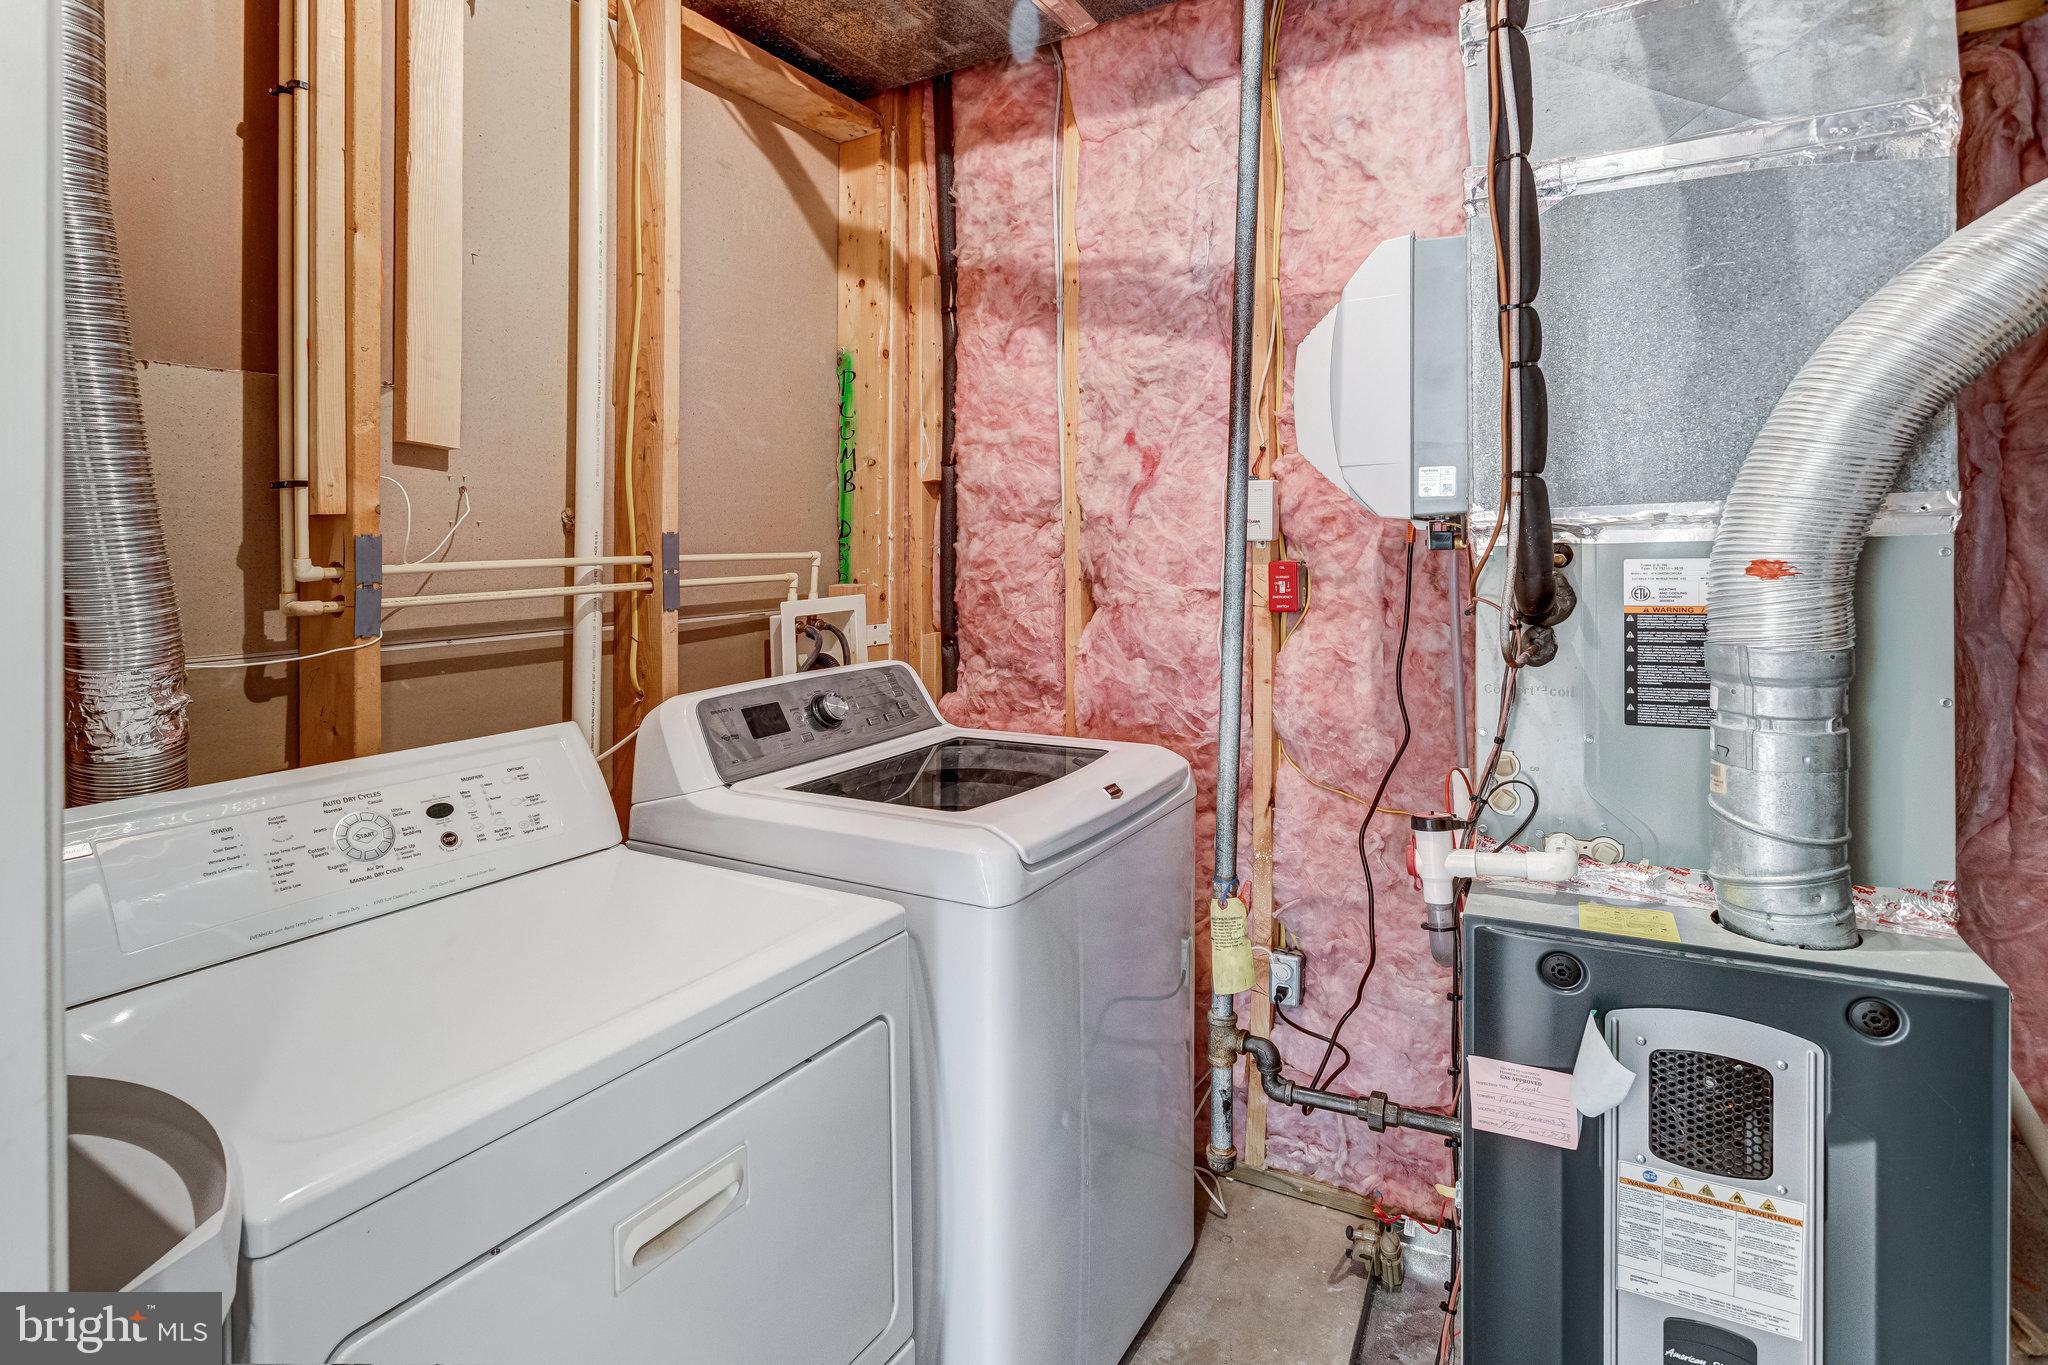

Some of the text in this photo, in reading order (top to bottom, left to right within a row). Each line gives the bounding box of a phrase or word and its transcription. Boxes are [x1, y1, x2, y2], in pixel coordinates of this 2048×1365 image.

[322, 791, 381, 808] AUTO DRY CYCLES
[211, 826, 234, 835] STATUS
[355, 831, 376, 840] START
[349, 875, 372, 884] MANUAL
[386, 866, 404, 875] CYCLES
[1627, 1179, 1803, 1227] WARNING AVERTISSEMENT ADVERTENCIA
[1664, 1348, 1706, 1365] American
